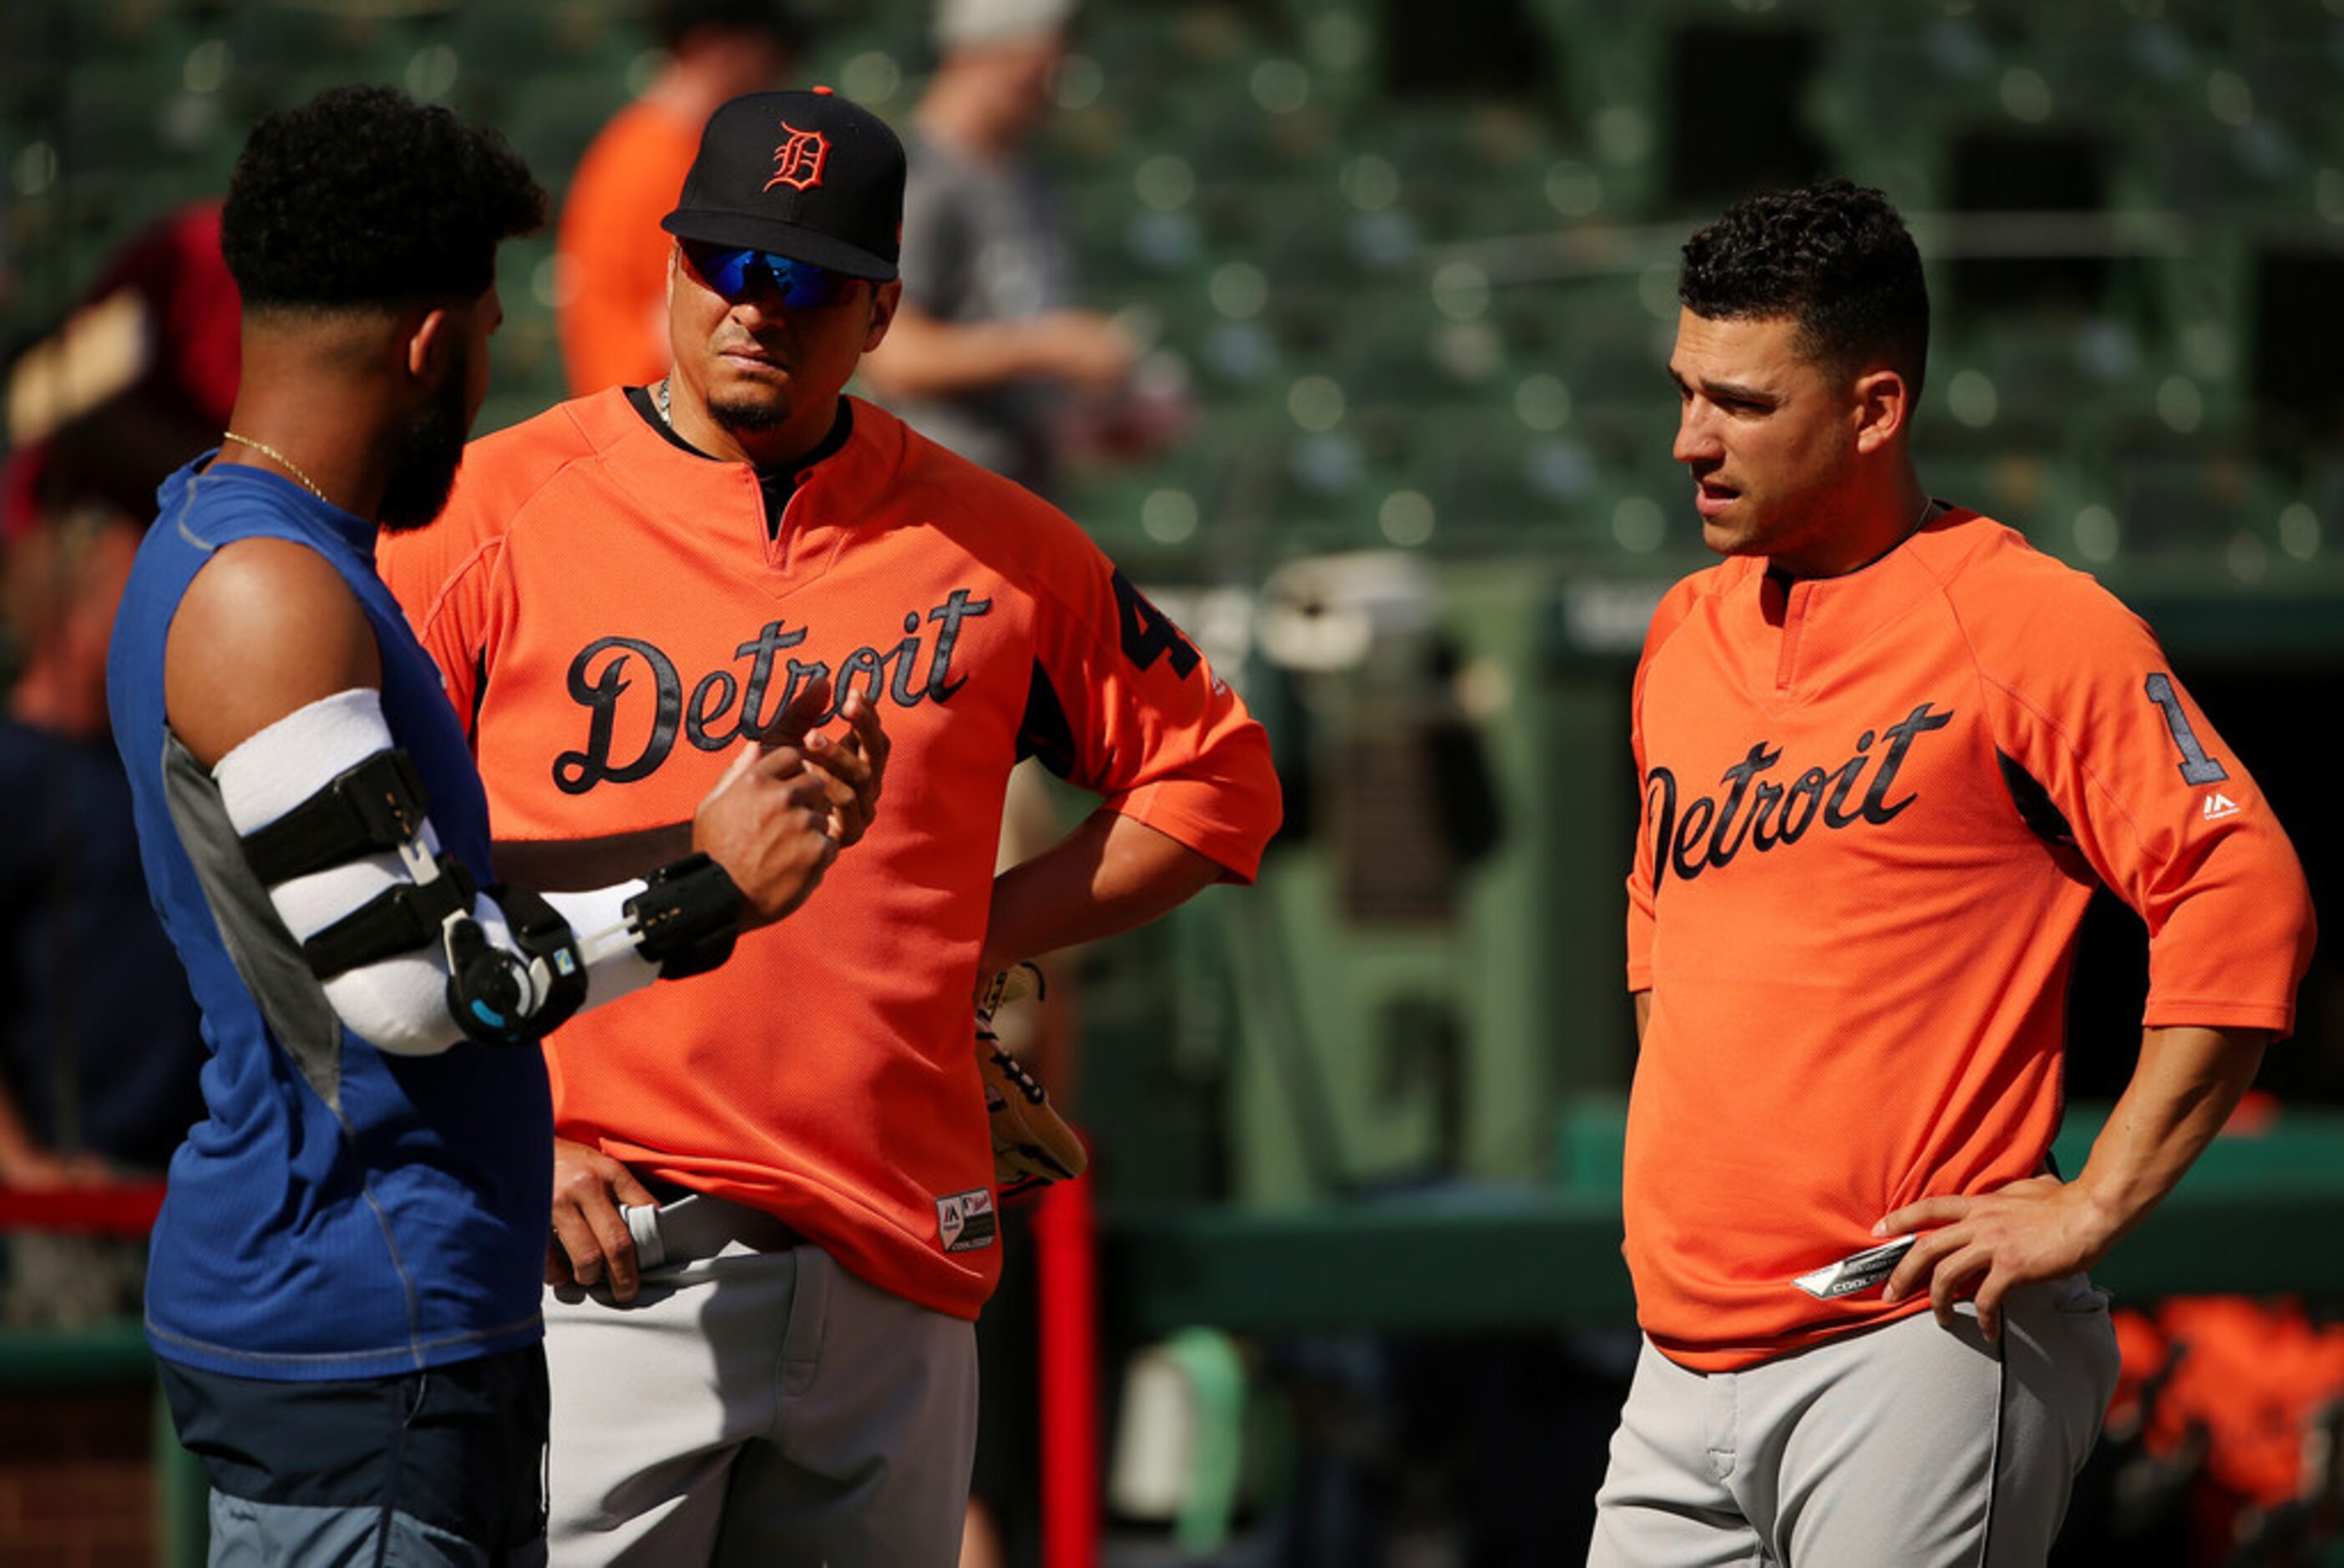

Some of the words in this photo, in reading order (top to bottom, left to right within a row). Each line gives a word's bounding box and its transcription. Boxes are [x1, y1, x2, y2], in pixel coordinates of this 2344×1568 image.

[763, 121, 833, 192] D
[552, 589, 992, 795] Detroit
[2144, 673, 2230, 787] 1
